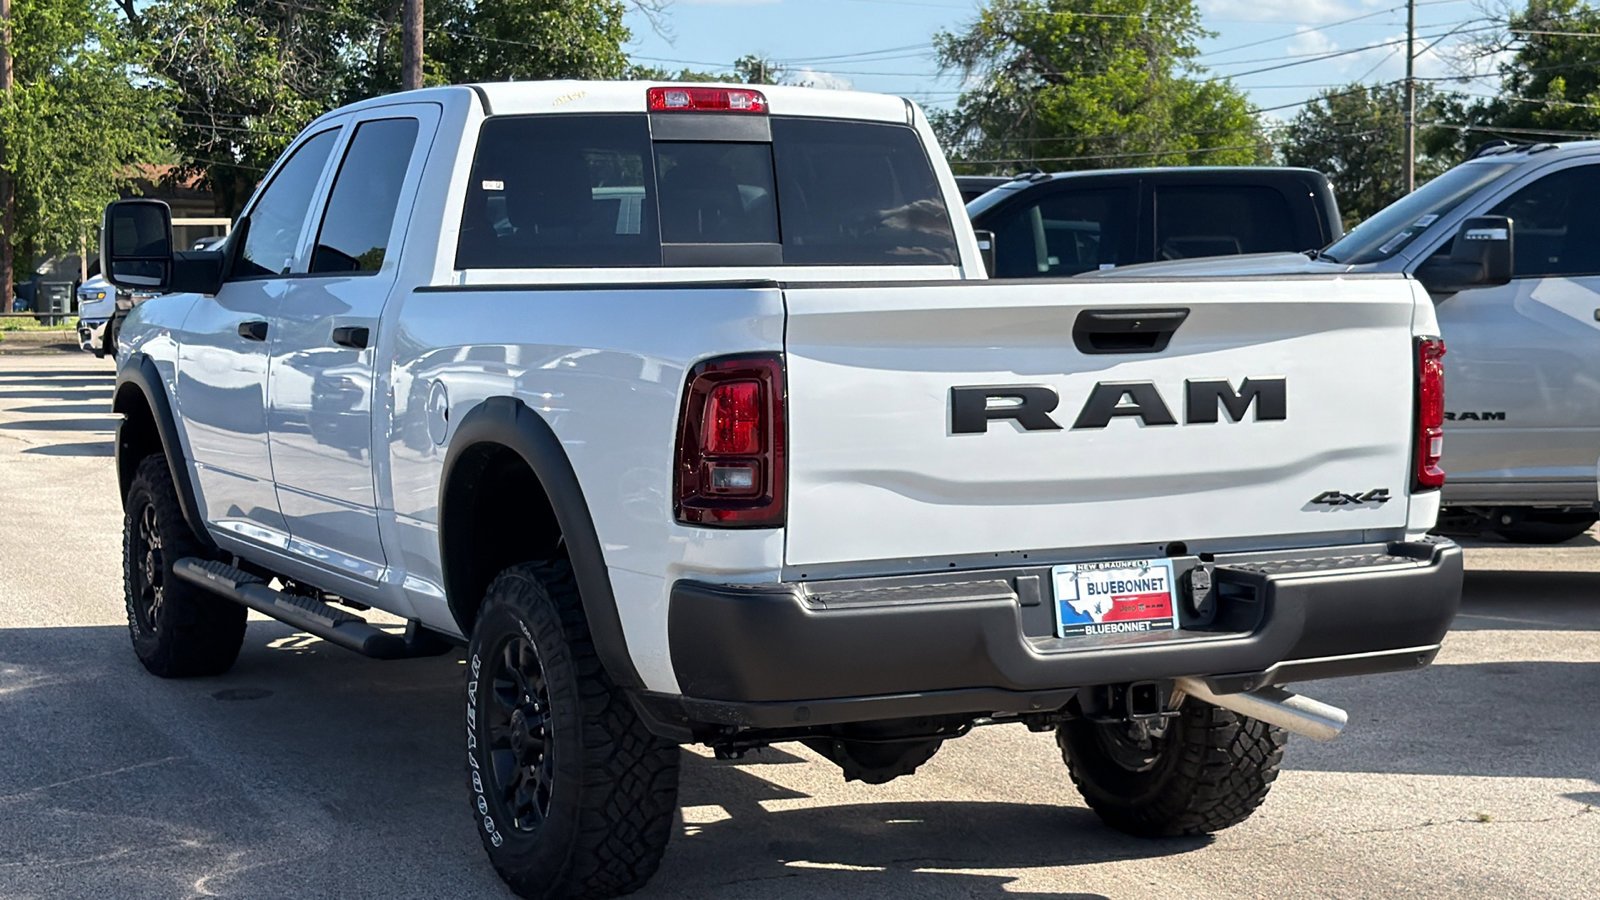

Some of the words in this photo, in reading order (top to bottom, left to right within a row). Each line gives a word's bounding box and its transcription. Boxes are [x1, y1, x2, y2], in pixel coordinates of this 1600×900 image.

[951, 376, 1287, 434] RAM
[1078, 562, 1097, 572] NEW
[1087, 578, 1164, 595] BLUEBONNET
[1085, 621, 1151, 635] BLUEBONNET
